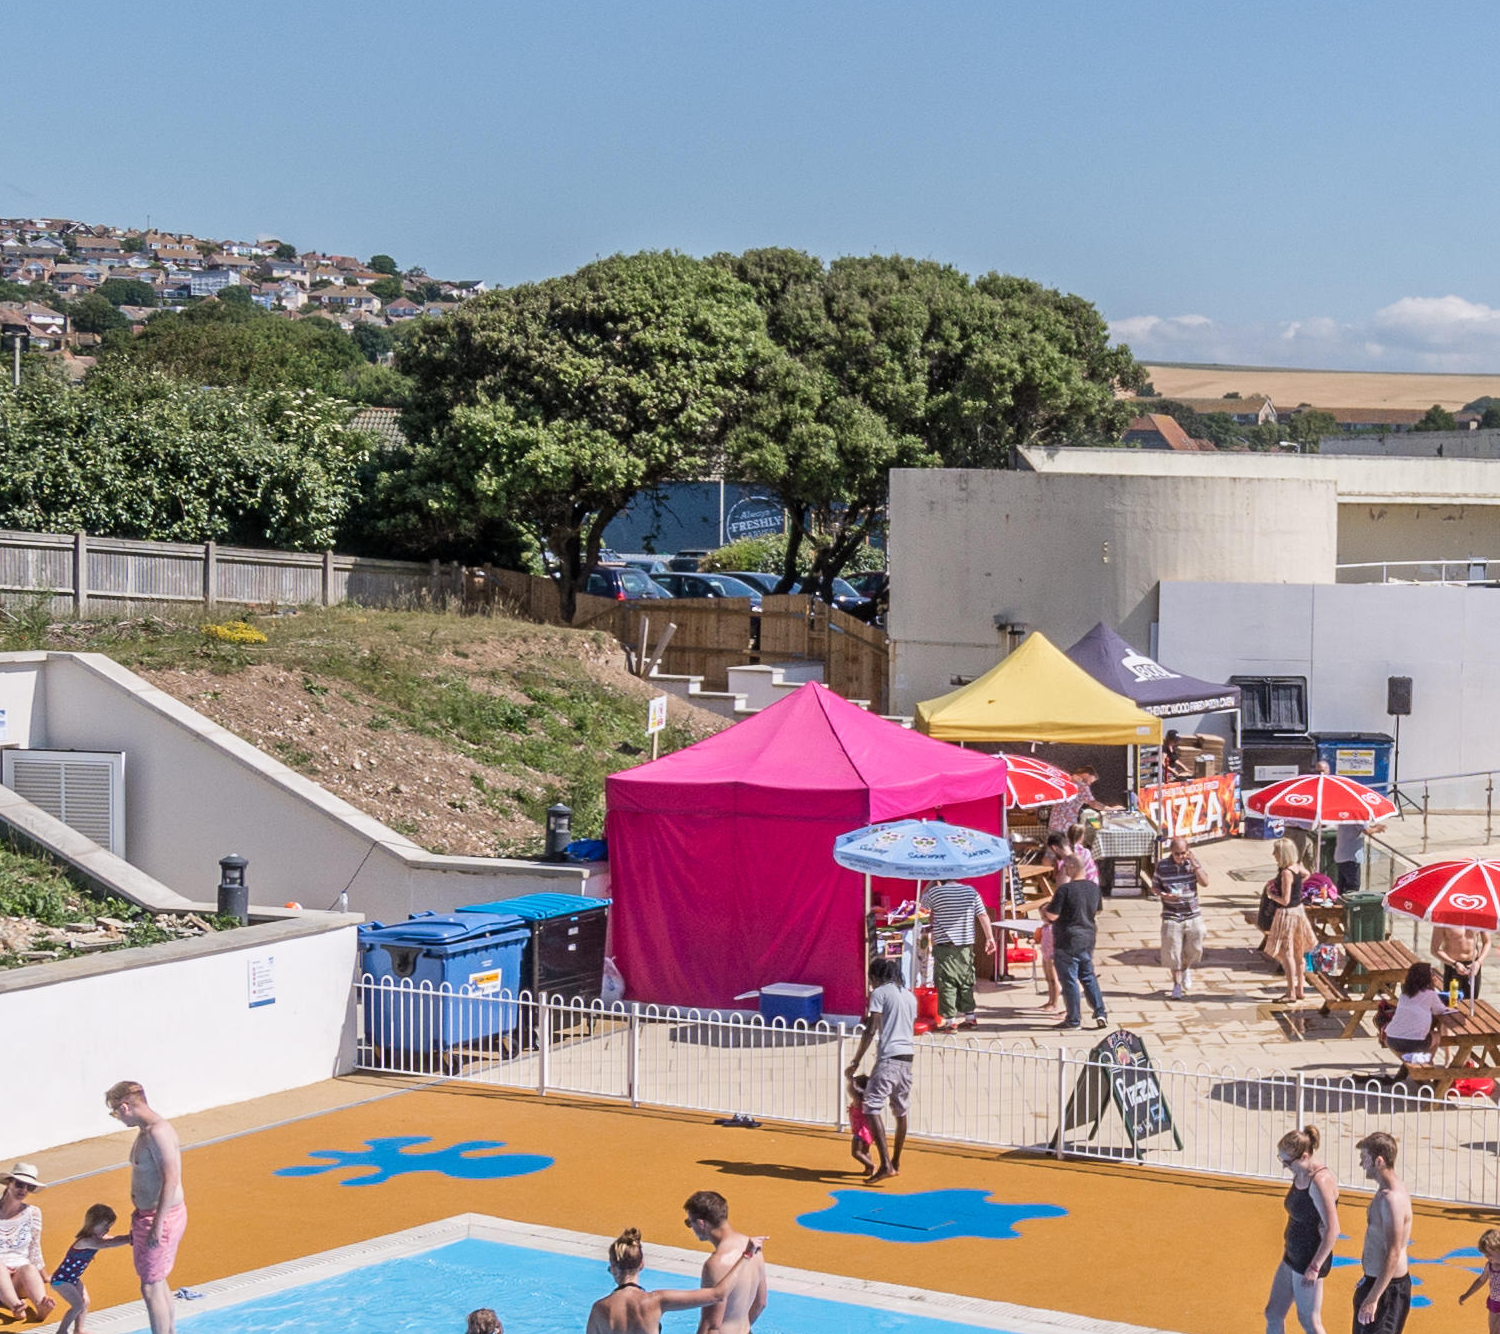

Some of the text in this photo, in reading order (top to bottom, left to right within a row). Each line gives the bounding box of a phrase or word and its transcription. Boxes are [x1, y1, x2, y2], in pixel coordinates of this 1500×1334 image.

[731, 516, 782, 532] FRESHLY
[1171, 702, 1190, 714] WOOD
[1148, 791, 1224, 838] PIZZA
